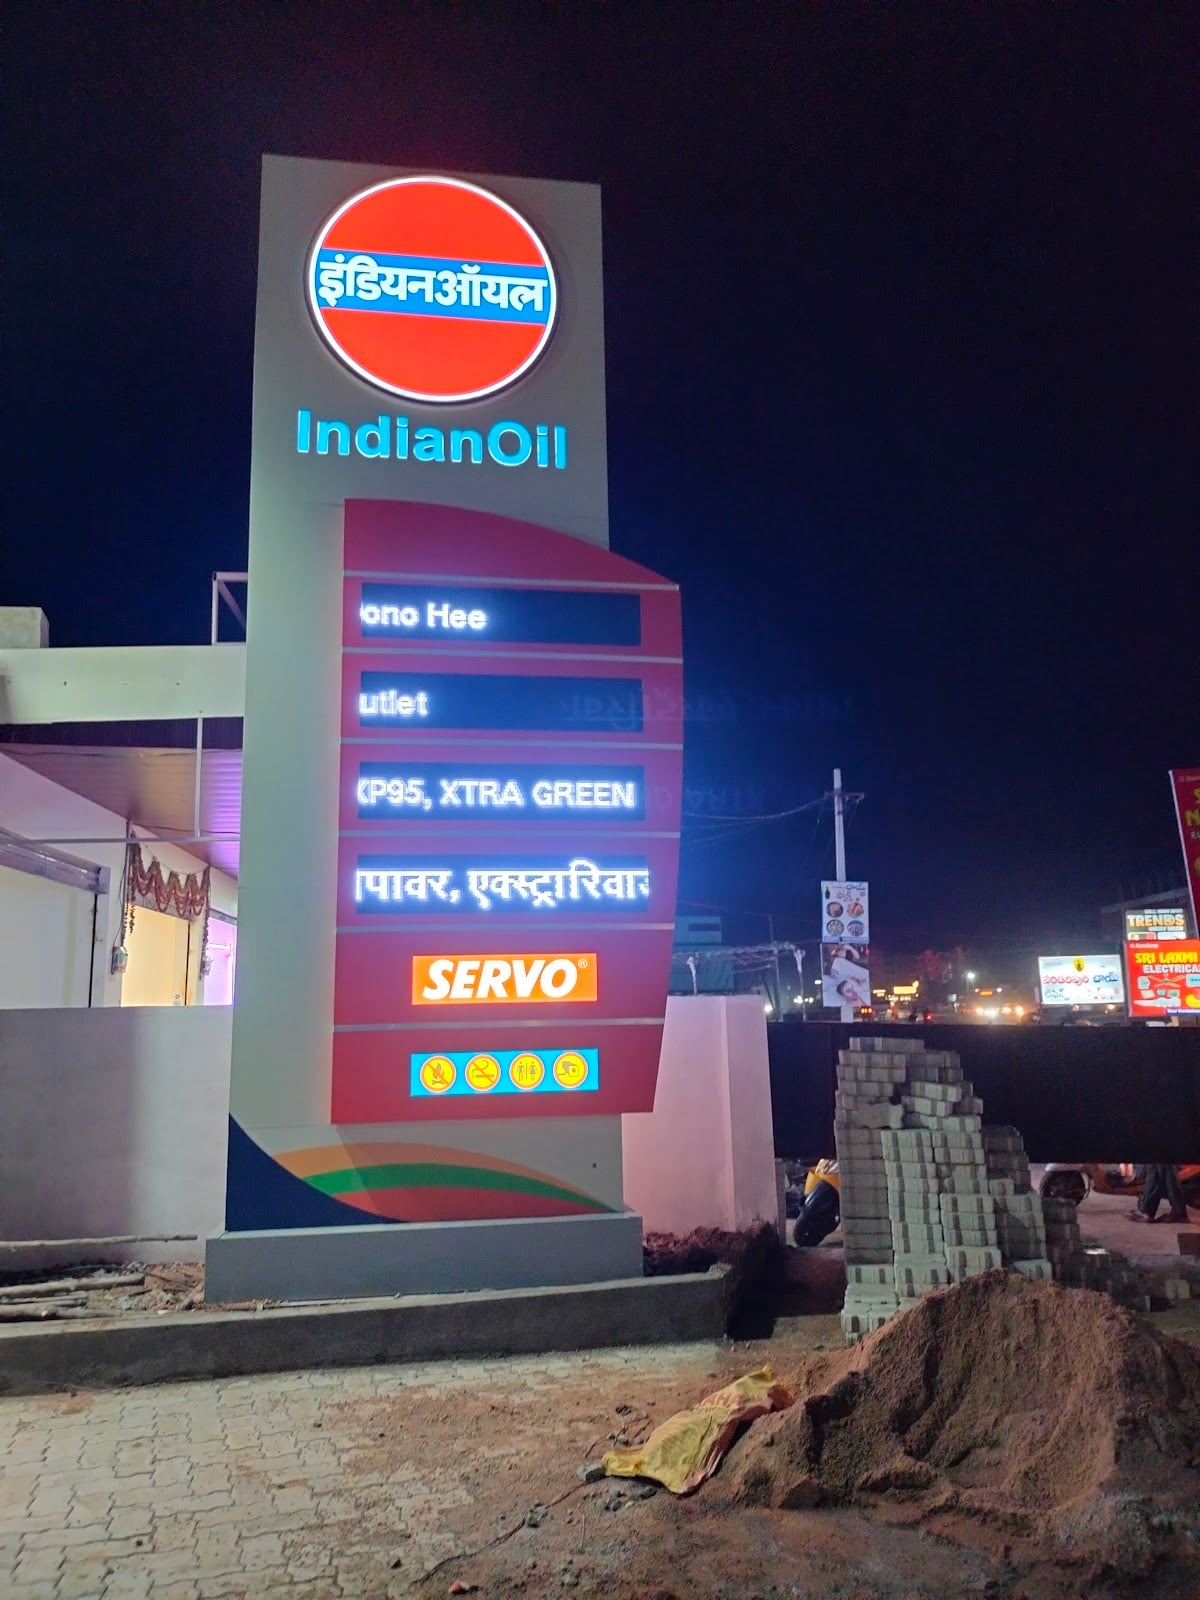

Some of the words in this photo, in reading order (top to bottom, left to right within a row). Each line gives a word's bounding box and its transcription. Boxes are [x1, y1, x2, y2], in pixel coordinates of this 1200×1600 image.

[318, 253, 548, 311] इंडियनऑयल
[297, 409, 567, 469] IndianOil
[360, 604, 418, 626] ono
[427, 602, 488, 629] Hee
[359, 690, 428, 715] utlet
[440, 778, 524, 806] XTRA
[532, 780, 636, 807] GREEN
[1127, 914, 1185, 927] TRENDS
[1135, 952, 1156, 964] SRI
[1159, 952, 1198, 964] LAXMI
[1143, 964, 1200, 974] ELECTRICA
